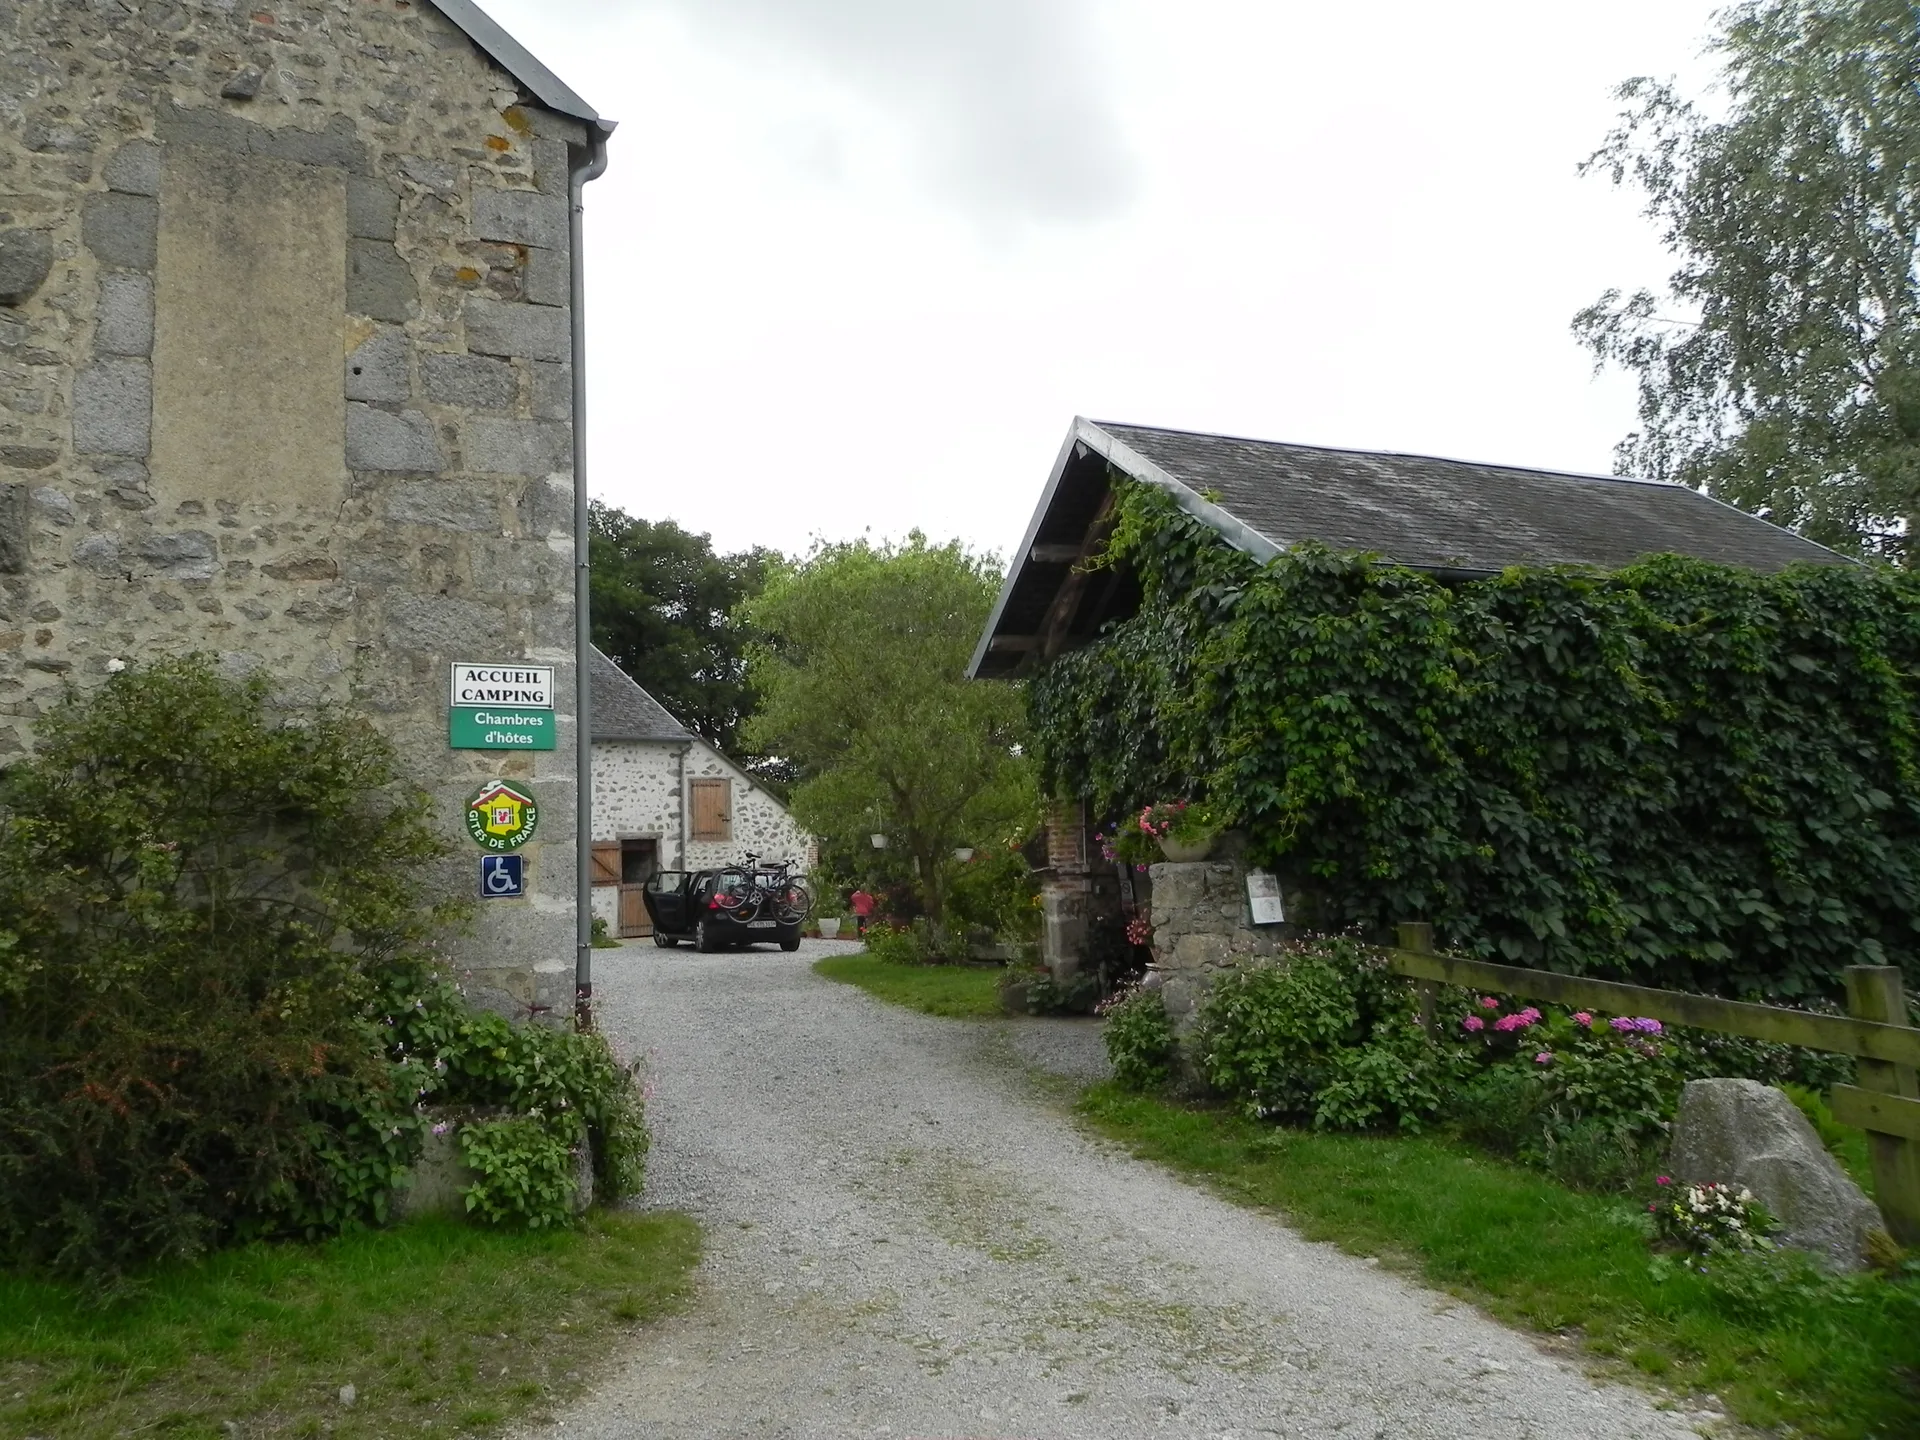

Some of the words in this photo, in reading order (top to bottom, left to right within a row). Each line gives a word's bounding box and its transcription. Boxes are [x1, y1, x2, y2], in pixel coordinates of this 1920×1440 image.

[465, 670, 542, 684] ACCUEIL
[461, 689, 544, 703] CAMPING
[474, 712, 544, 726] Chambres
[484, 731, 534, 744] d'hôtes
[488, 838, 505, 849] DE
[510, 807, 536, 847] FRANCE
